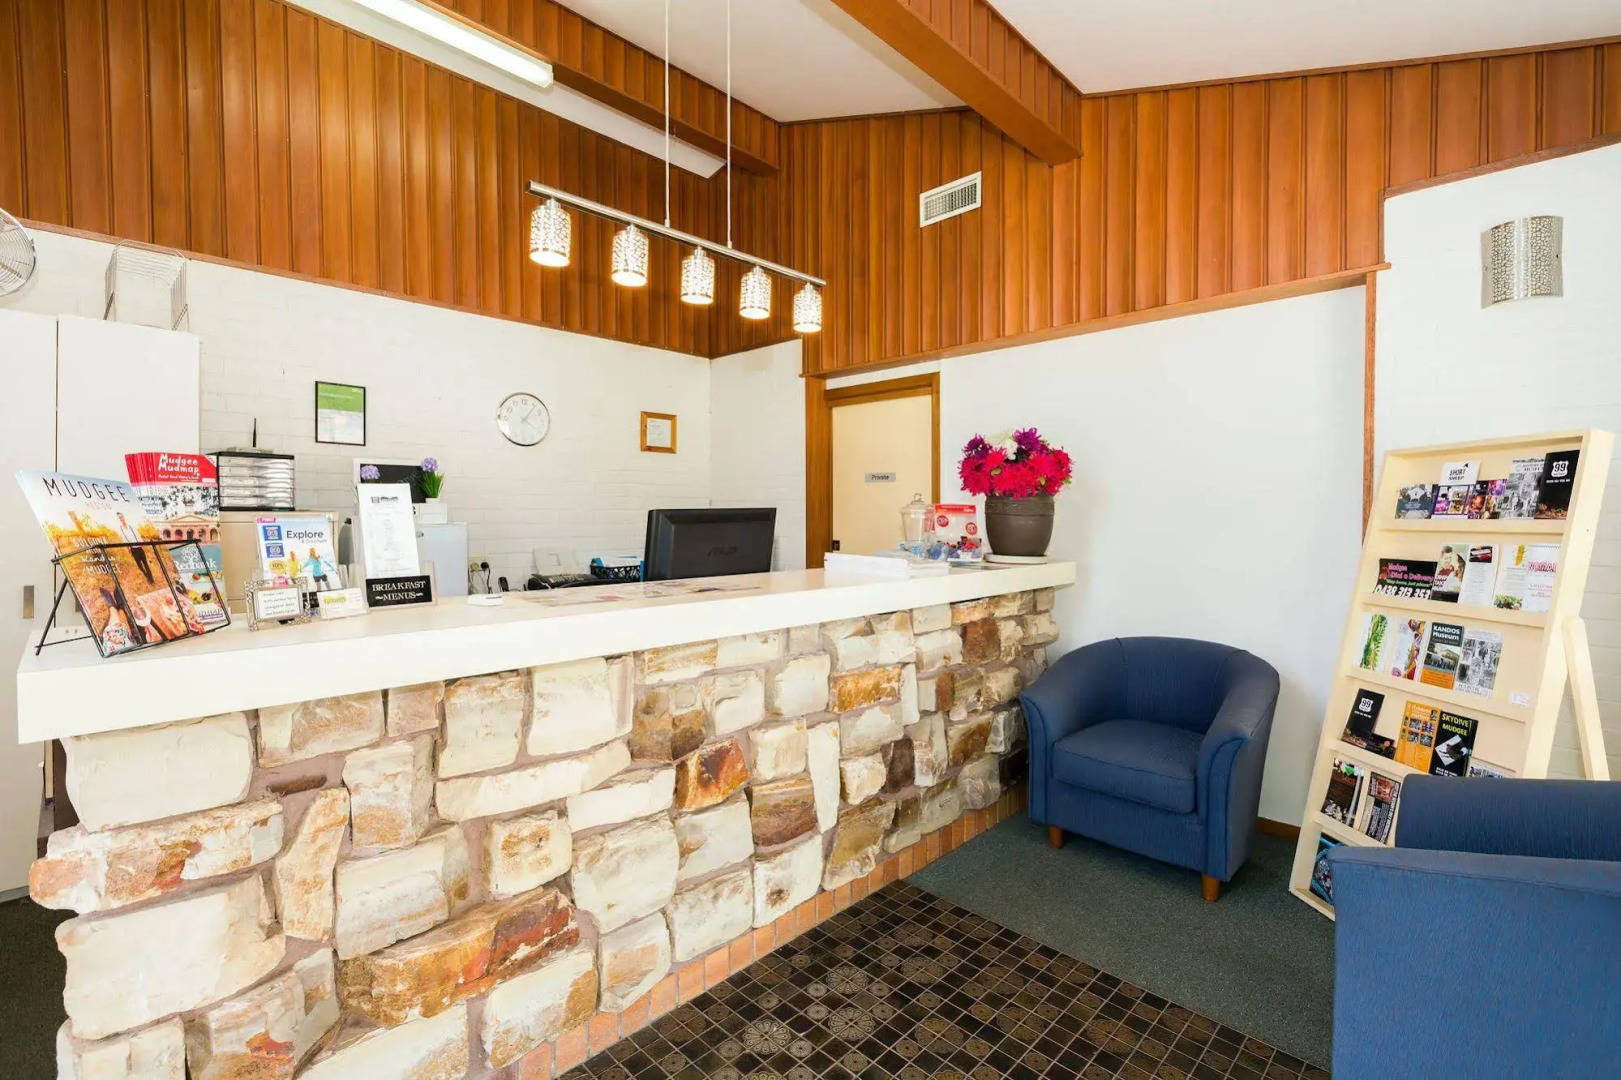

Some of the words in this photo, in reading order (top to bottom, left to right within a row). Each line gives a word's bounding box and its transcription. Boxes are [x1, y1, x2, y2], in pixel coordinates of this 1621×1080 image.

[159, 453, 198, 467] Mudgee
[158, 461, 200, 475] Mudmap
[1554, 462, 1567, 473] 99
[42, 477, 131, 502] MUDGEE
[286, 530, 324, 540] Explore
[371, 581, 426, 592] BREAKFAST
[383, 591, 416, 602] MENUS
[1432, 625, 1460, 635] KANDOS
[1432, 631, 1459, 641] Museum
[1361, 698, 1371, 709] 99
[1441, 713, 1469, 728] SKYDIVE
[1442, 723, 1468, 736] MUDGEE
